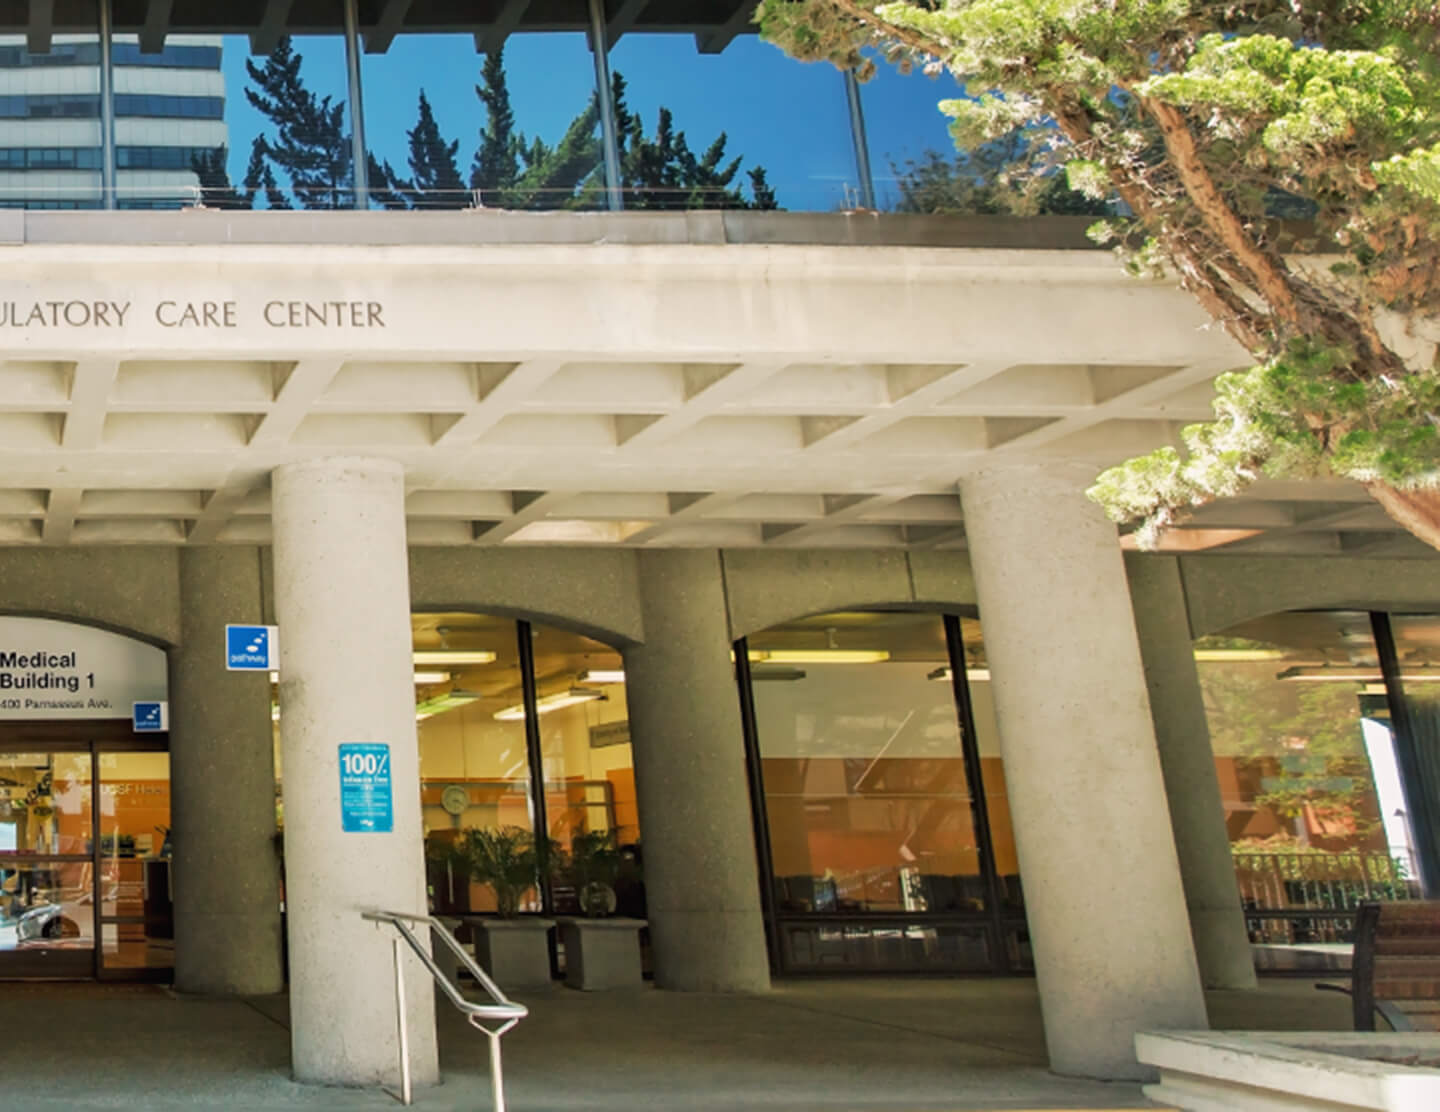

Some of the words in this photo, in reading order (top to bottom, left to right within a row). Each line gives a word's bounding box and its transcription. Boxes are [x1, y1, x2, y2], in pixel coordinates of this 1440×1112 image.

[155, 301, 237, 327] CARE
[264, 301, 386, 328] CENTER
[0, 652, 76, 669] Medical
[0, 673, 79, 692] Building
[86, 673, 94, 689] 1
[0, 700, 20, 710] 400
[25, 700, 84, 710] Parnassus
[87, 700, 113, 710] Ave.
[342, 753, 388, 774] 100%
